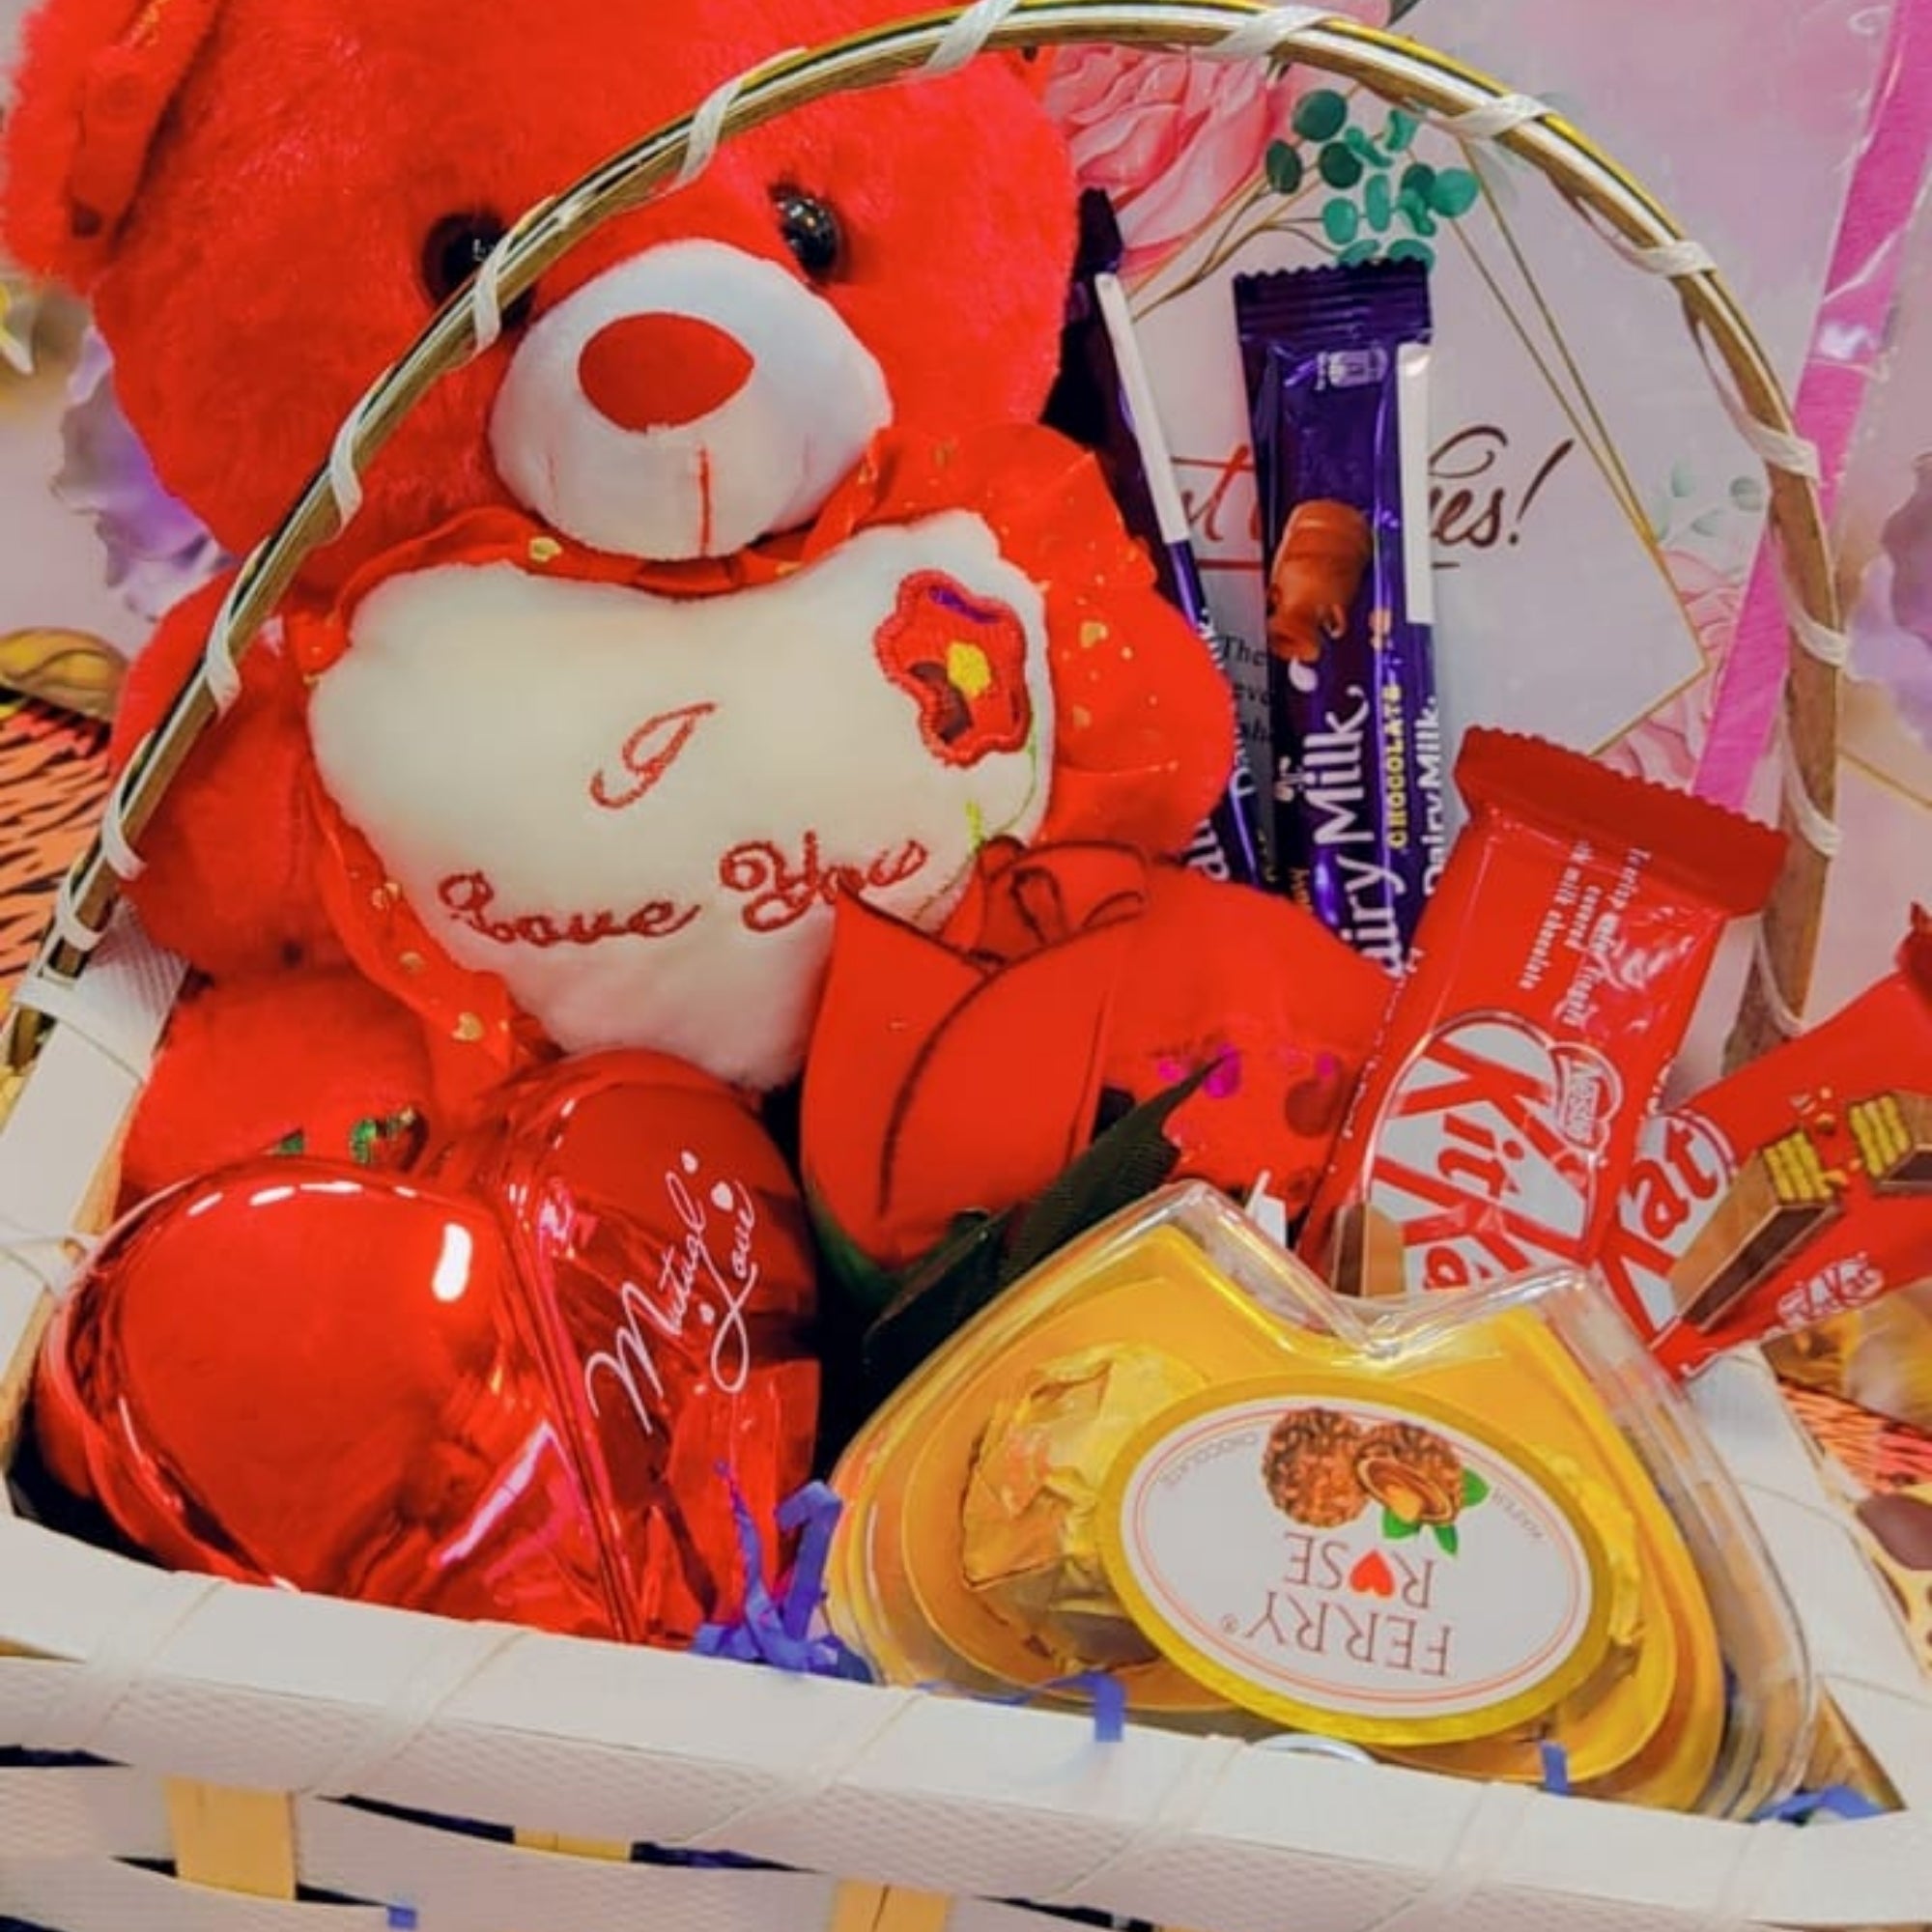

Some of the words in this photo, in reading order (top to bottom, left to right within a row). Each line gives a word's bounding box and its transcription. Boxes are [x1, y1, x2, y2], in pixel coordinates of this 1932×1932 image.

[1303, 684, 1377, 845] Milk
[1283, 1530, 1435, 1610] RSE
[1245, 1591, 1453, 1679] FERRY
